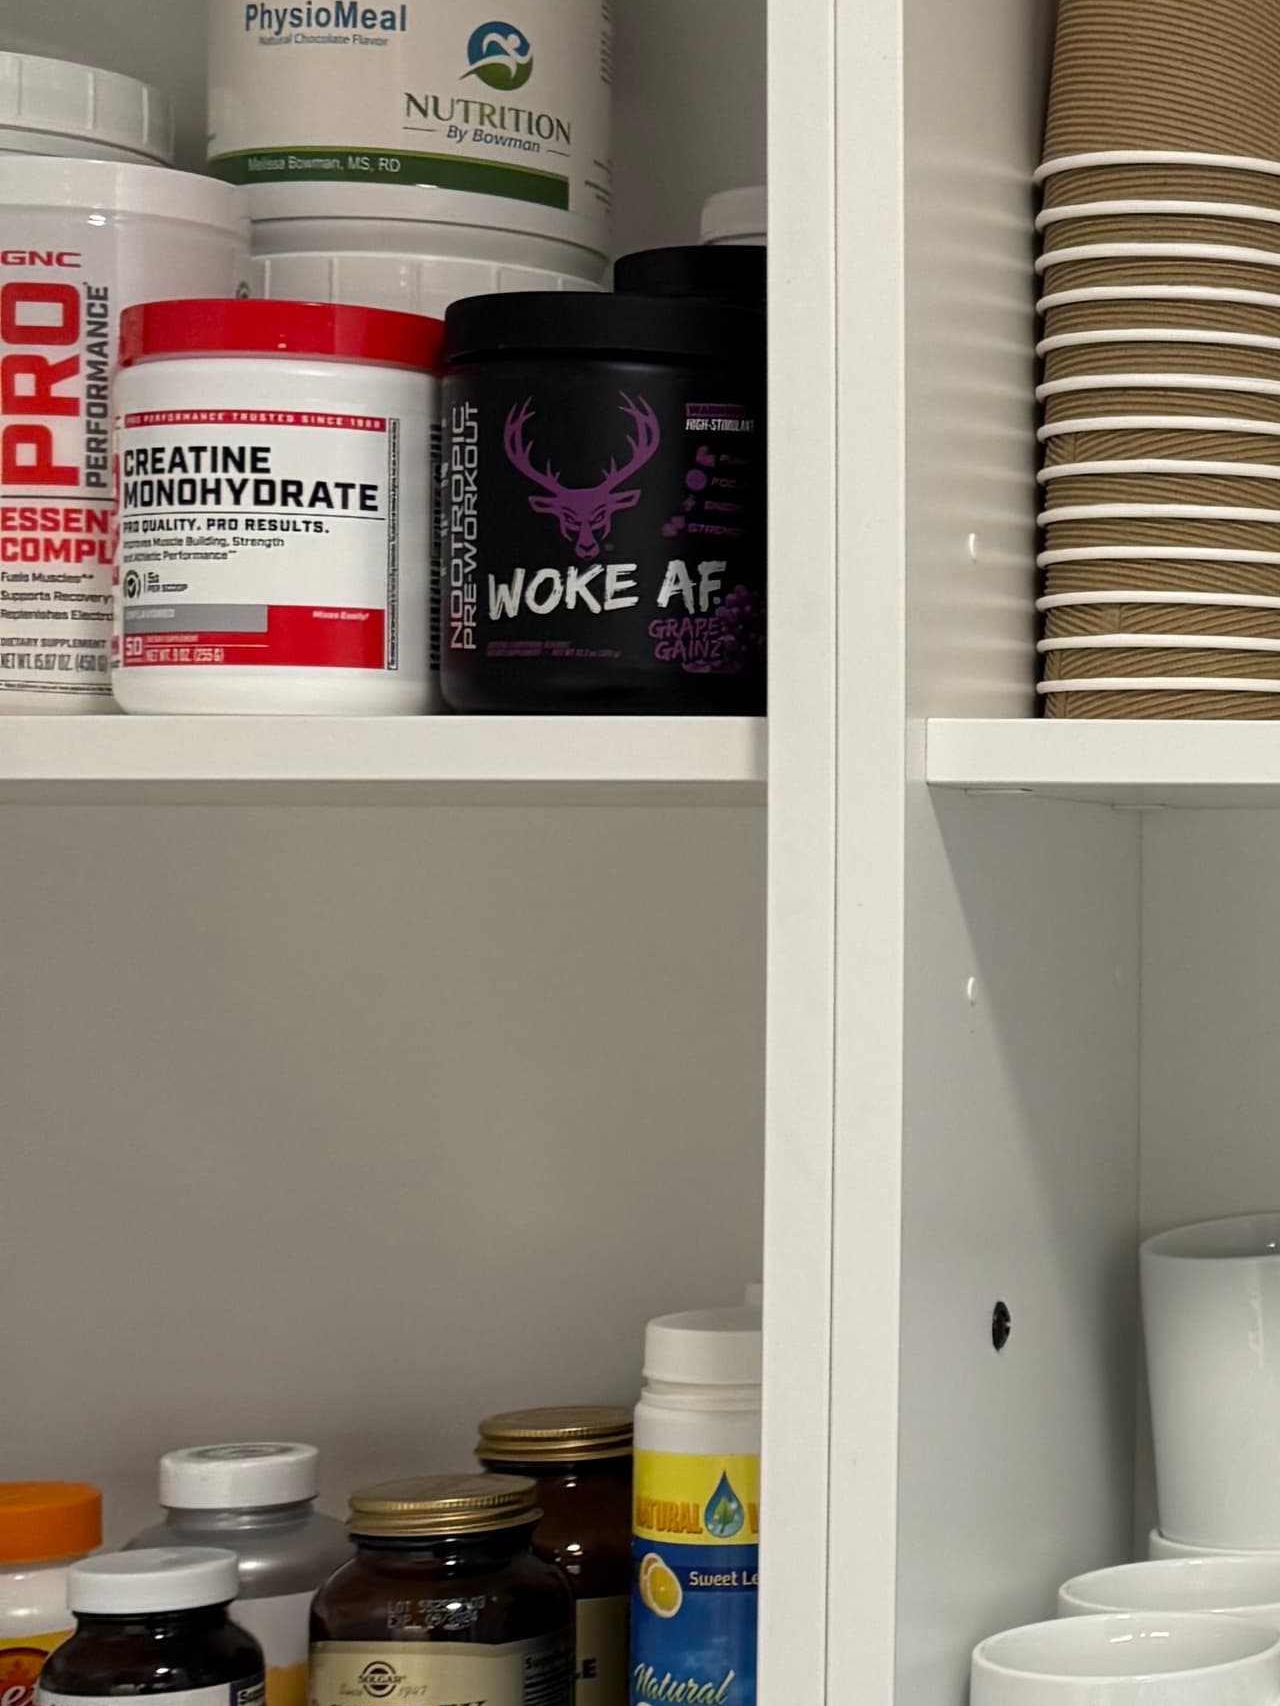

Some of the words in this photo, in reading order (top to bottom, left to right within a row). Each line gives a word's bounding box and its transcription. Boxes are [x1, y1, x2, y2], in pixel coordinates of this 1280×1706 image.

[245, 0, 407, 36] PhysioMeal
[402, 92, 572, 146] NUTRITION
[446, 124, 470, 145] By
[472, 128, 541, 154] Bowman
[377, 157, 401, 173] RD
[0, 250, 82, 269] GNC
[0, 281, 82, 487] PRO
[85, 286, 109, 490] PERFORMANCE
[123, 445, 272, 478] CREATINE
[123, 477, 379, 513] MONOHYDRATE
[141, 518, 202, 533] QUALITY.
[206, 518, 239, 531] PRO
[244, 519, 331, 535] RESULTS.
[449, 405, 465, 649] NOOTROPIC
[463, 401, 479, 650] PRE-WORKOUT
[487, 562, 640, 622] WOKE
[647, 616, 722, 640] GRAPE
[124, 636, 143, 657] 50
[654, 639, 722, 662] GAINZ
[688, 1570, 736, 1587] Sweet
[633, 1663, 735, 1706] Natural
